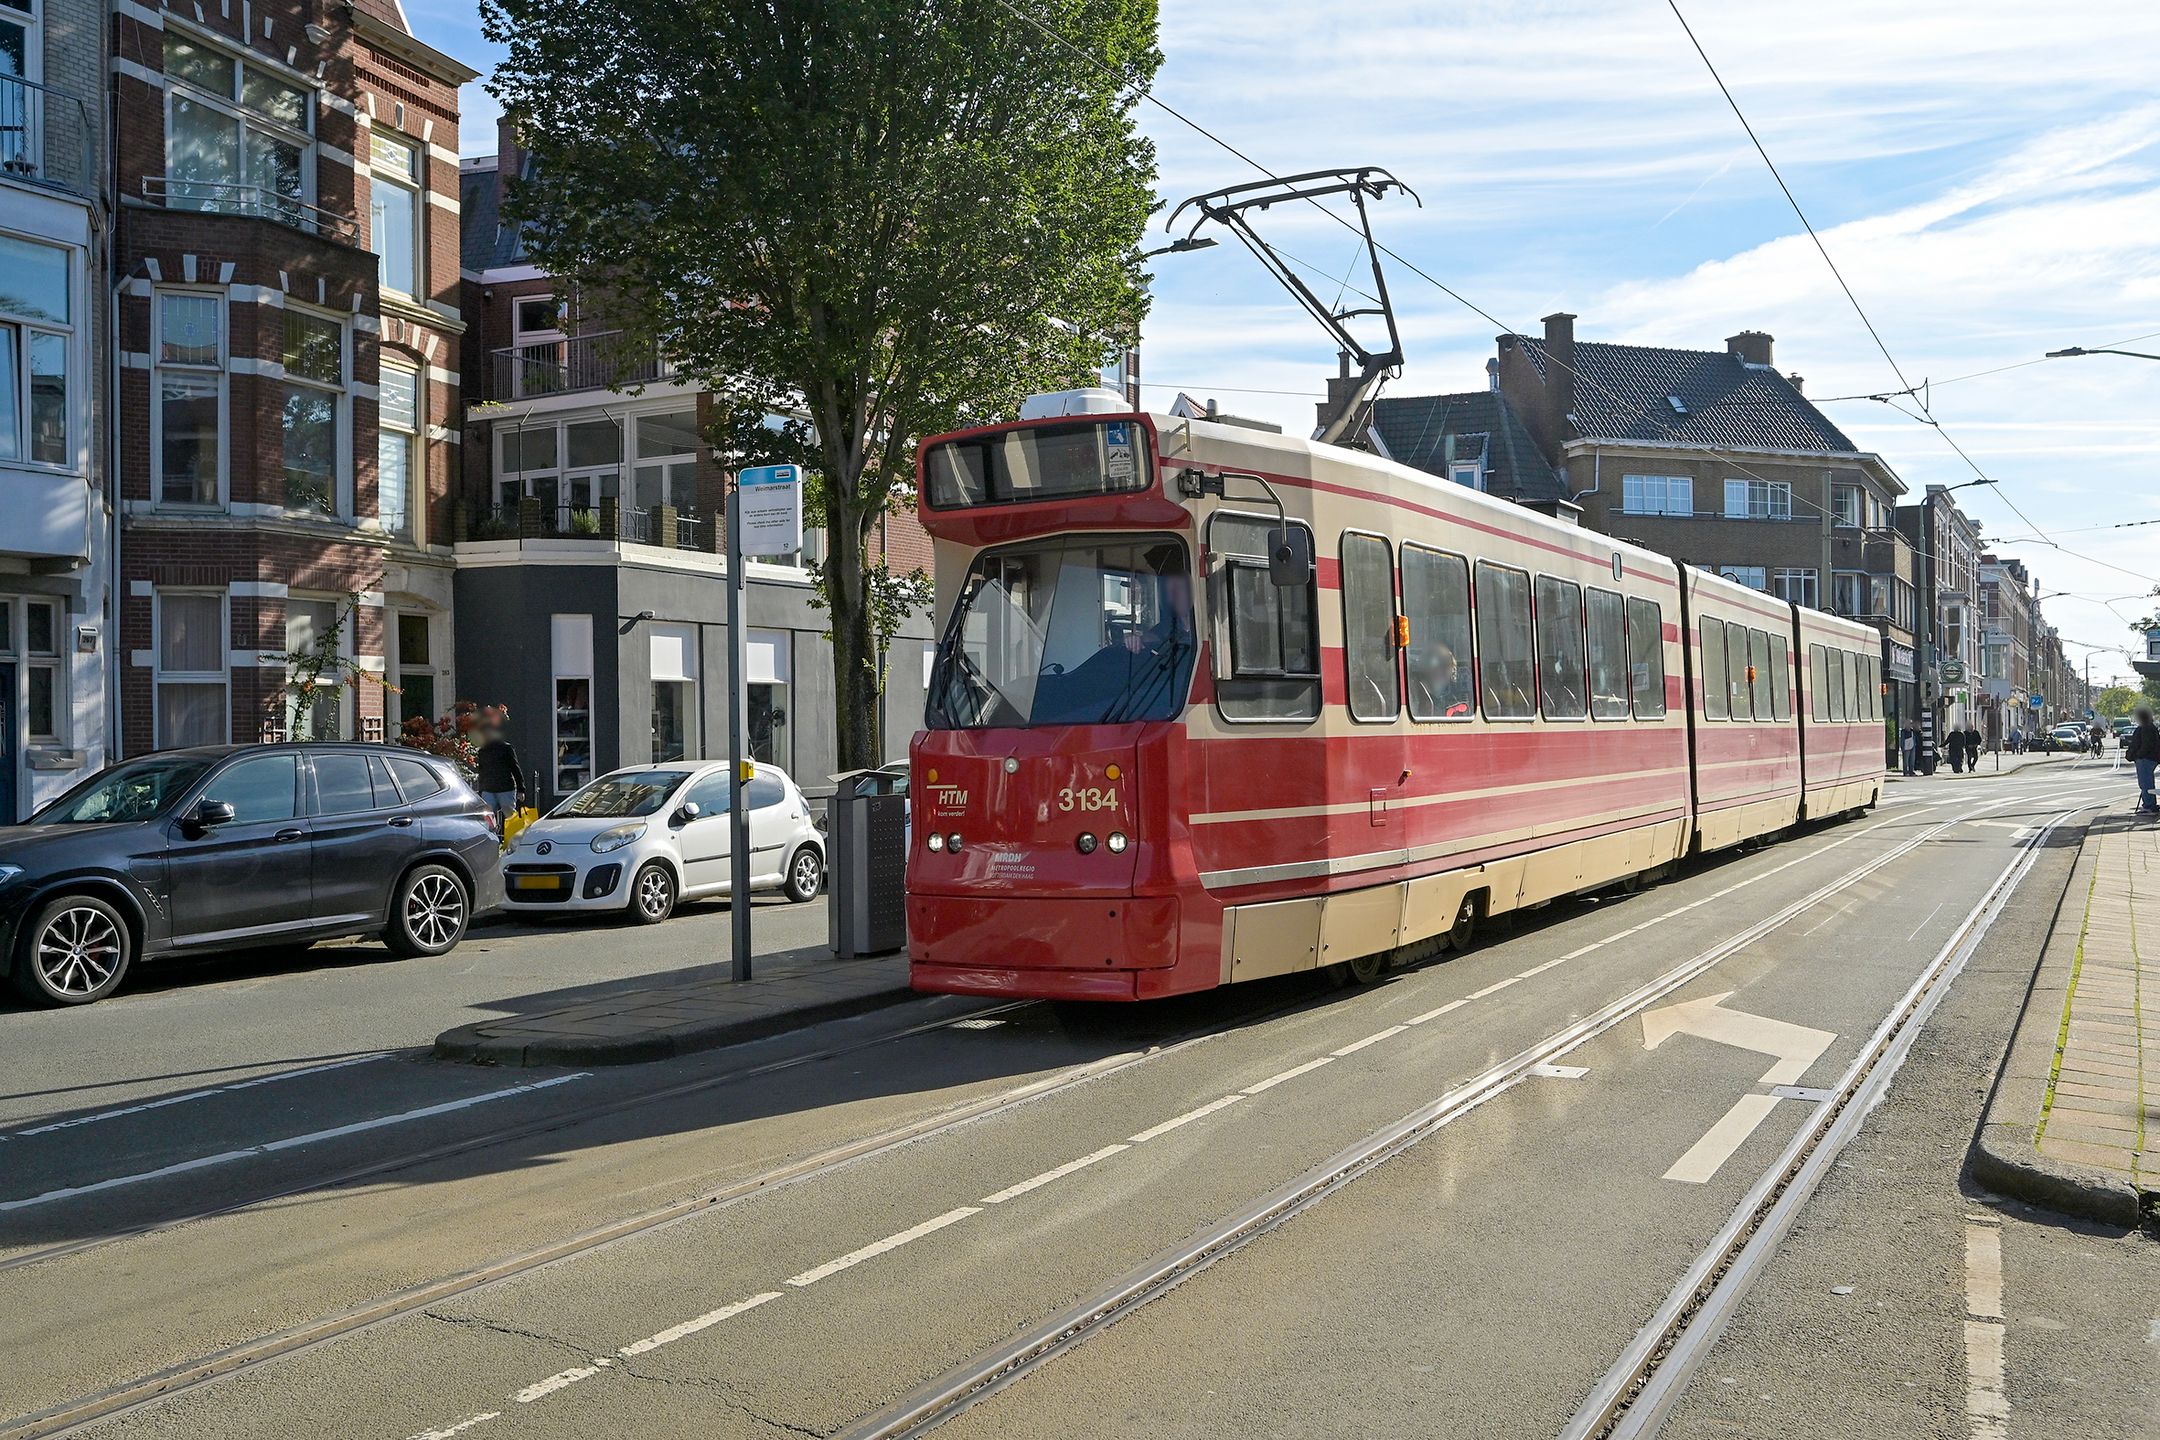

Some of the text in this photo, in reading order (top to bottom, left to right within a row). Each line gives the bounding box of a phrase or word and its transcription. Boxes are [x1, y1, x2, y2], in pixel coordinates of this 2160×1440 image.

[754, 484, 791, 492] Weimarstraat
[938, 790, 968, 805] HTM
[1058, 788, 1118, 812] 3134
[994, 852, 1022, 863] MRDH
[990, 864, 1035, 872] METROPOOLREGIO
